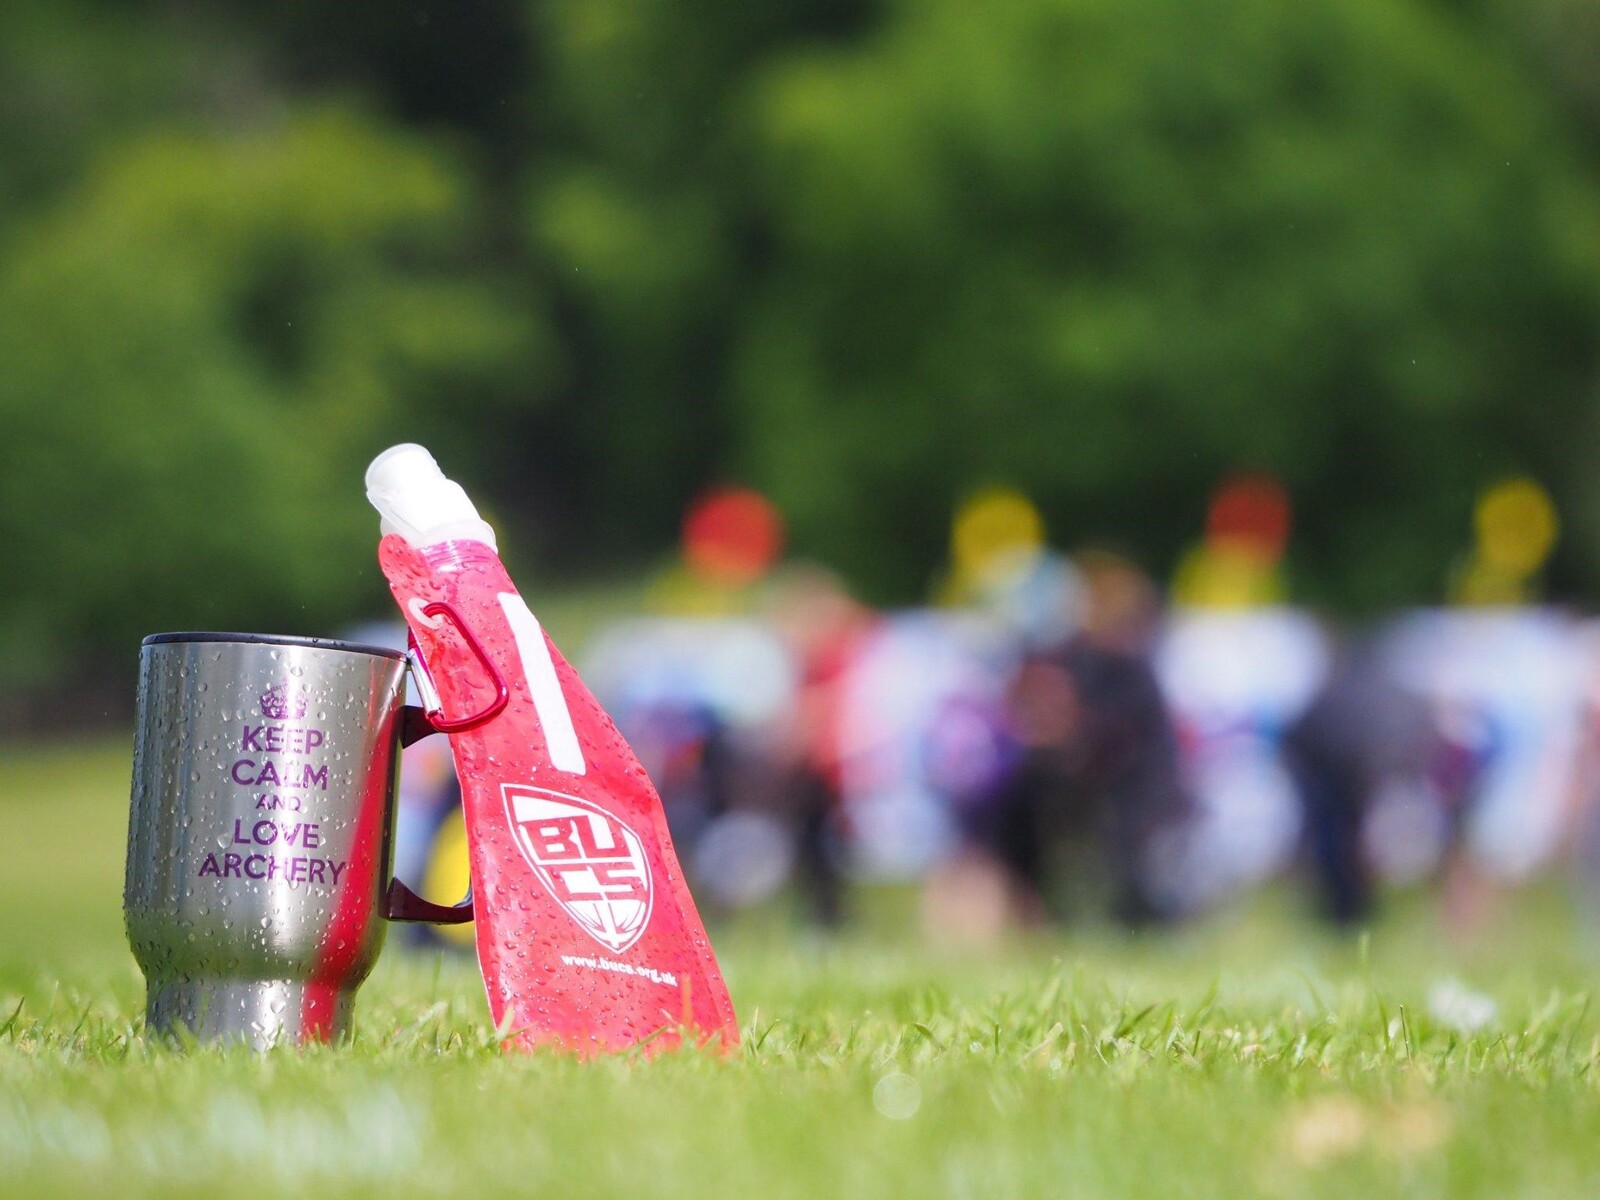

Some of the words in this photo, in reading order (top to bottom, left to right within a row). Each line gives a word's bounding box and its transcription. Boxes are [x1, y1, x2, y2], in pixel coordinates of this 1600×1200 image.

[242, 725, 324, 755] KEEP
[231, 759, 329, 791] CALM
[255, 793, 302, 812] AND
[234, 818, 320, 849] LOVE
[198, 852, 347, 886] ARCHERY
[561, 954, 679, 987] www.bucs.org.uk
